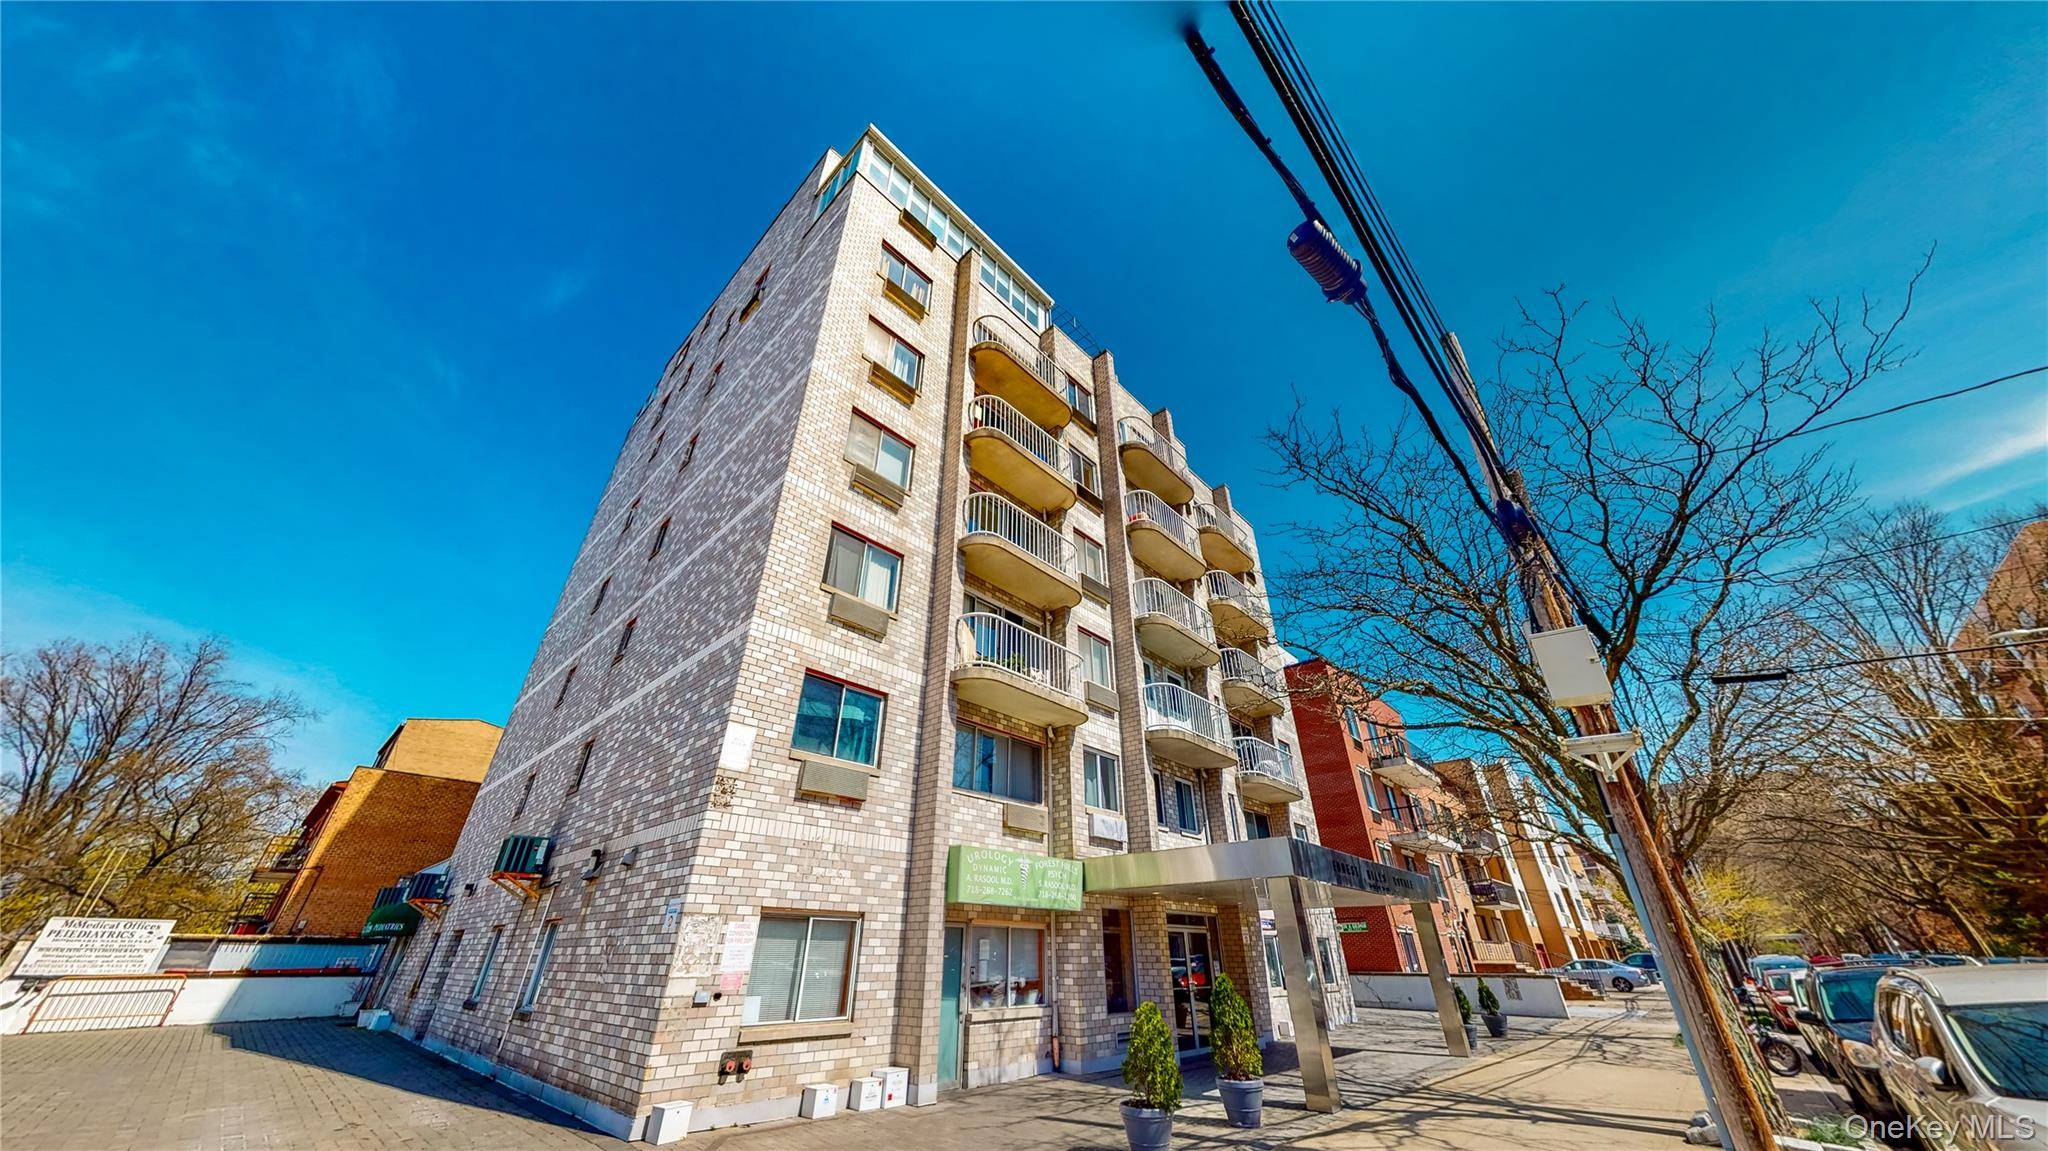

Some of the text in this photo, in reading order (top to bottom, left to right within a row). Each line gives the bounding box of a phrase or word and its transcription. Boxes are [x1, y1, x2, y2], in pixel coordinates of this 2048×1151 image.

[967, 849, 1014, 867] UROLOGY
[973, 863, 1008, 874] DYNAMIC
[1035, 860, 1059, 870] FOREST
